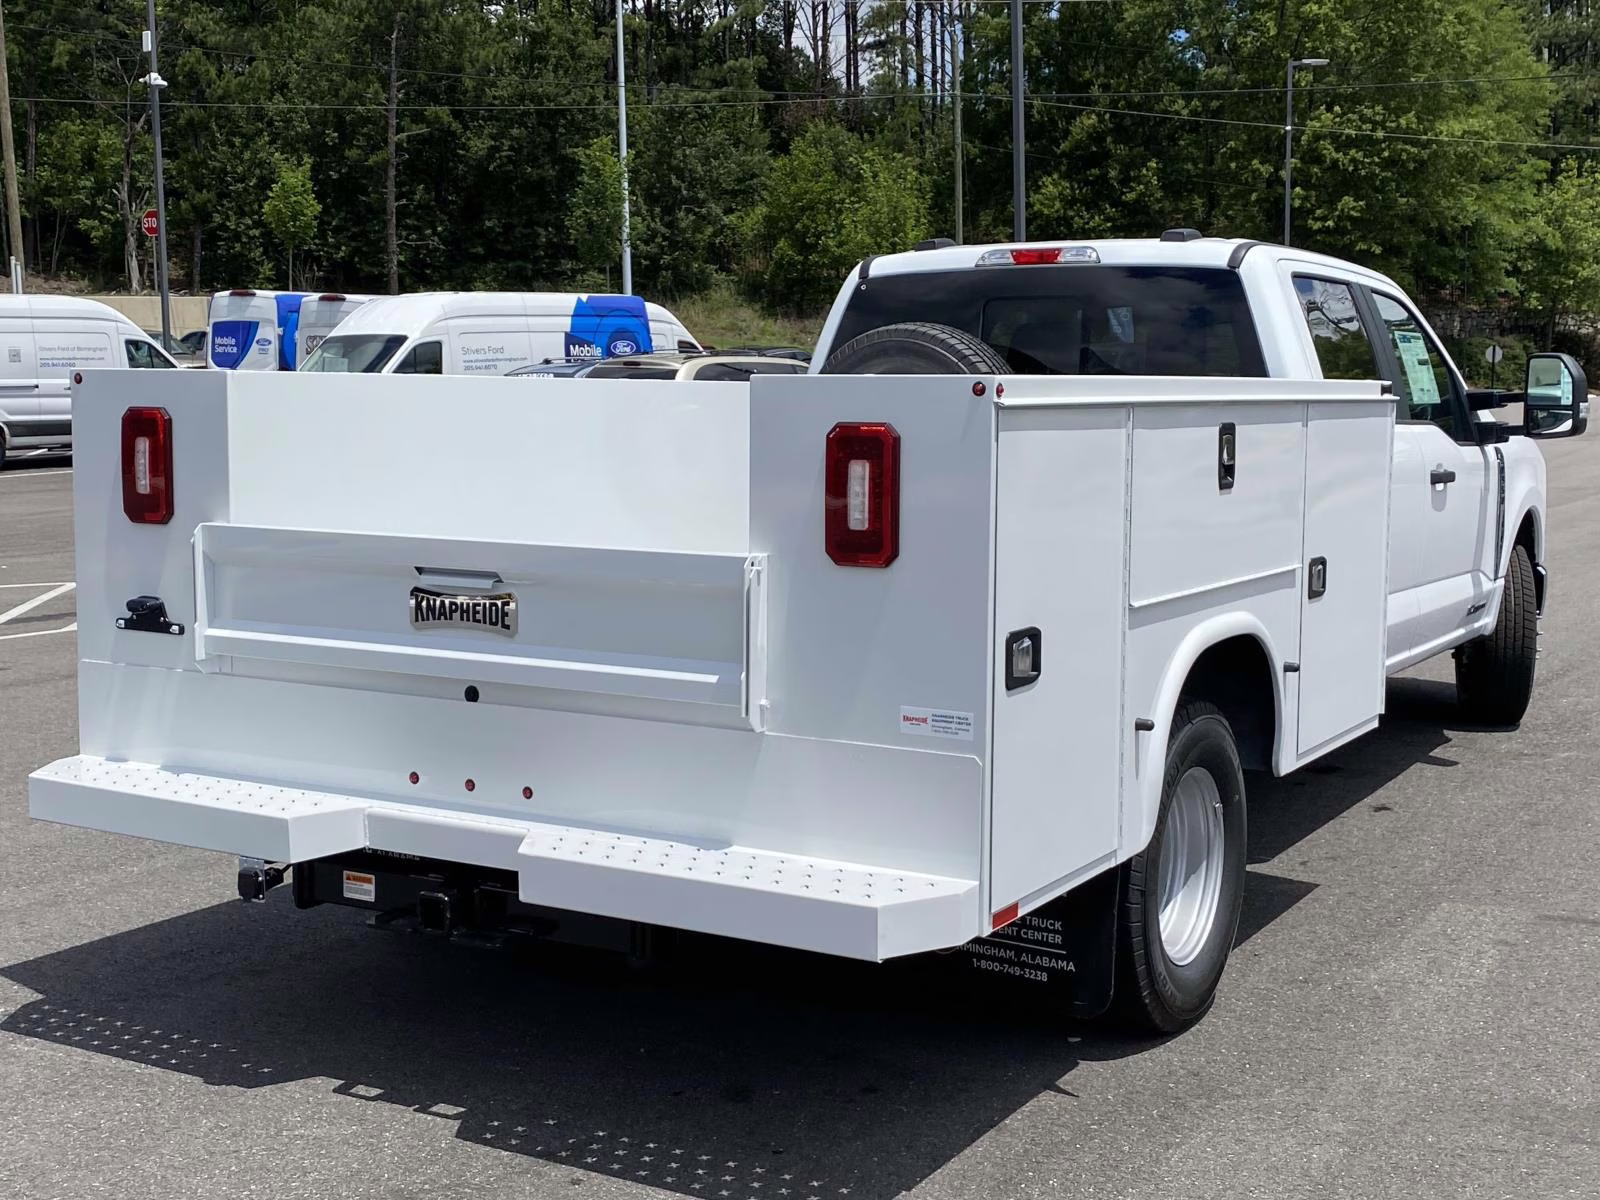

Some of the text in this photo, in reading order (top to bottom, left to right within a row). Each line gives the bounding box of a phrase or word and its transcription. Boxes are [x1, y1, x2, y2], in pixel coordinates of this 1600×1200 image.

[143, 217, 158, 228] STO
[214, 336, 236, 345] Mobile
[214, 345, 237, 353] Service
[461, 345, 504, 355] Stivers Ford
[569, 344, 602, 356] Mobile
[614, 342, 633, 353] Ford
[414, 593, 511, 630] KNAPHEIDE
[1025, 915, 1062, 931] TRUCK
[1020, 927, 1063, 944] CENTER
[958, 942, 1076, 972] MINGHAM, ALABAMA
[972, 958, 1048, 981] 1-800-749-3238
